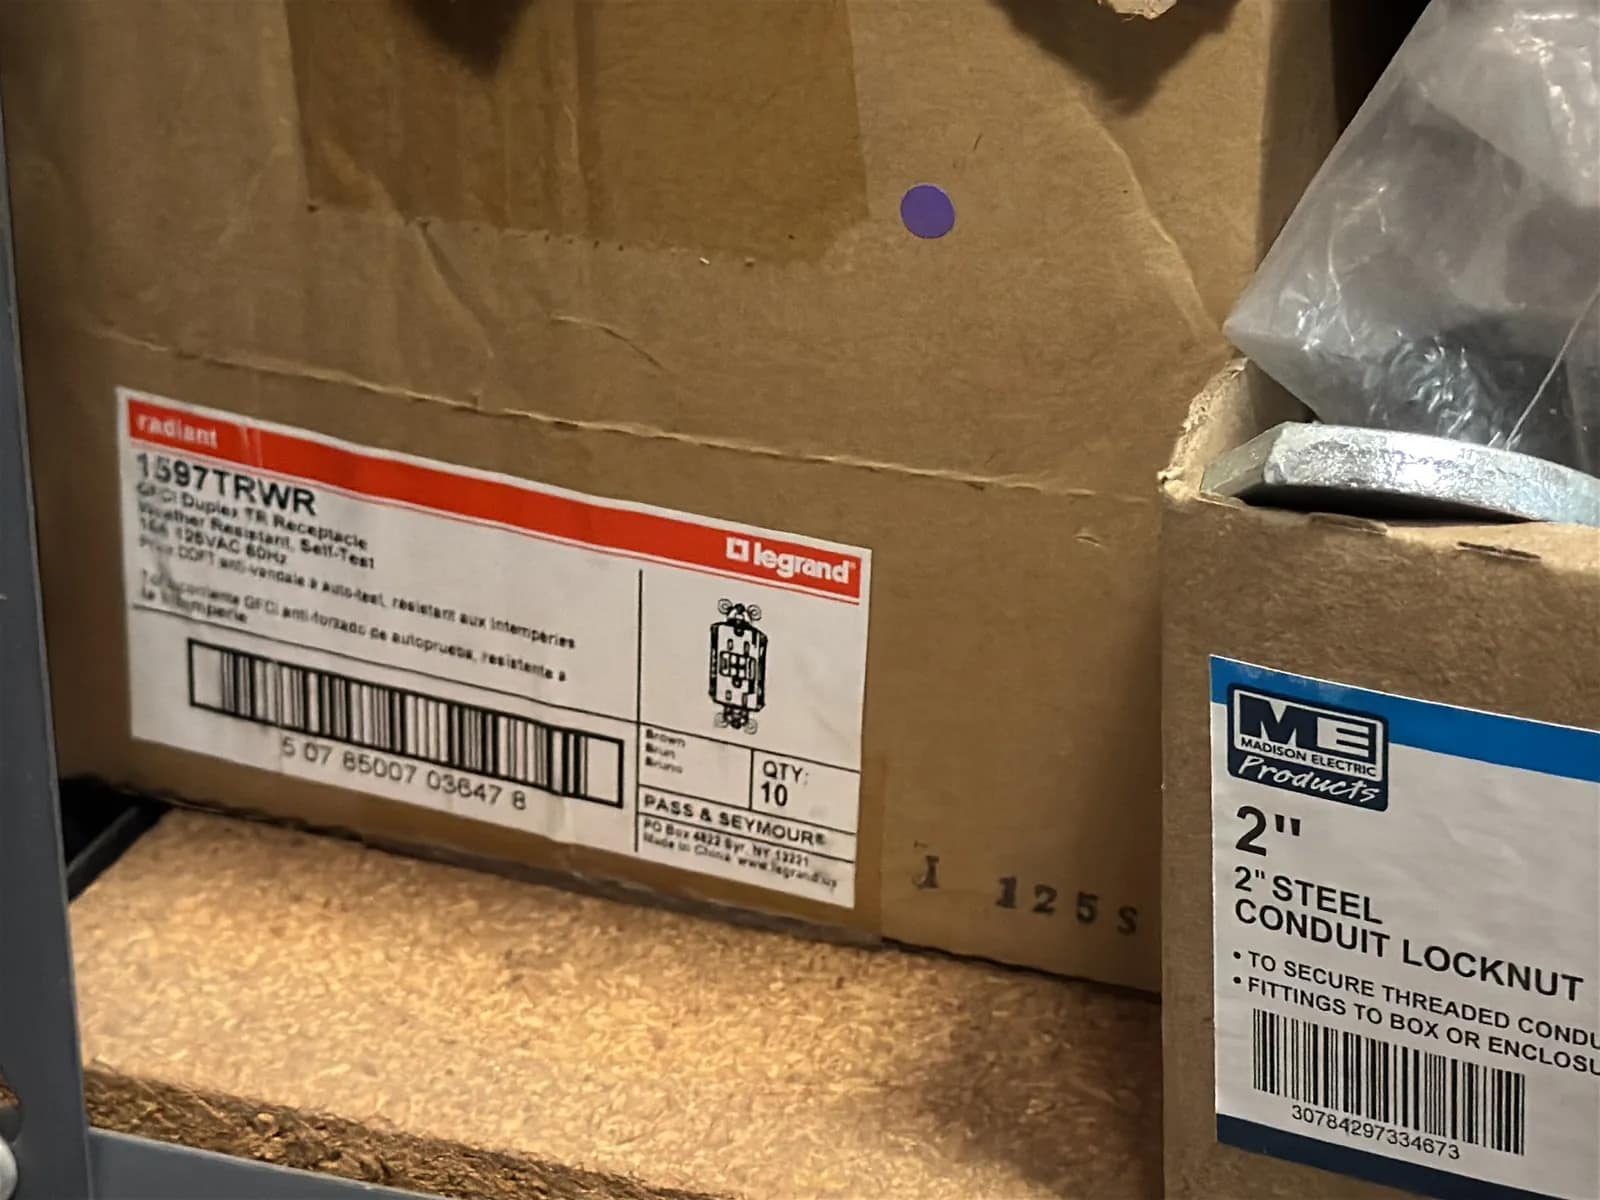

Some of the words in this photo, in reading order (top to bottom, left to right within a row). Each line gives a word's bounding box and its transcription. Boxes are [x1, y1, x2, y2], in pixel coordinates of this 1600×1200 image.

[136, 413, 218, 448] radiant
[136, 453, 317, 516] 1597TRWR
[181, 492, 238, 520] Duplex
[244, 506, 268, 526] TR
[273, 514, 368, 551] Receptacle
[246, 543, 287, 566] 60Hz
[300, 537, 375, 570] Self-Test
[369, 625, 388, 642] de
[459, 613, 487, 630] aux
[645, 728, 686, 748] Brown
[645, 742, 676, 760] Brun
[281, 736, 296, 758] 5
[304, 742, 333, 766] 07
[343, 754, 417, 785] 85007
[426, 769, 502, 805] 03647
[511, 790, 527, 811] 8
[762, 760, 810, 786] QTY:
[1240, 736, 1308, 763] MADISON
[1311, 753, 1377, 778] ELECTRIC
[760, 781, 789, 807] 10
[1238, 755, 1381, 803] Products
[643, 794, 693, 818] PASS
[700, 808, 712, 823] &
[643, 819, 662, 833] PO
[666, 826, 690, 840] Box
[1234, 805, 1301, 857] 2"
[693, 843, 731, 864] China
[1234, 866, 1266, 892] 2"
[1272, 875, 1383, 925] STEEL
[1235, 898, 1391, 958] CONDUIT
[1402, 939, 1585, 1002] LOCKNUT
[1250, 951, 1276, 972] TO
[1284, 961, 1375, 997] SECURE
[1382, 985, 1510, 1029] THREADED
[1249, 977, 1347, 1015] FITTINGS
[1354, 1004, 1383, 1025] TO
[1390, 1014, 1439, 1040] BOX
[1446, 1027, 1480, 1049] OR
[1291, 1105, 1460, 1160] 30784297334673
